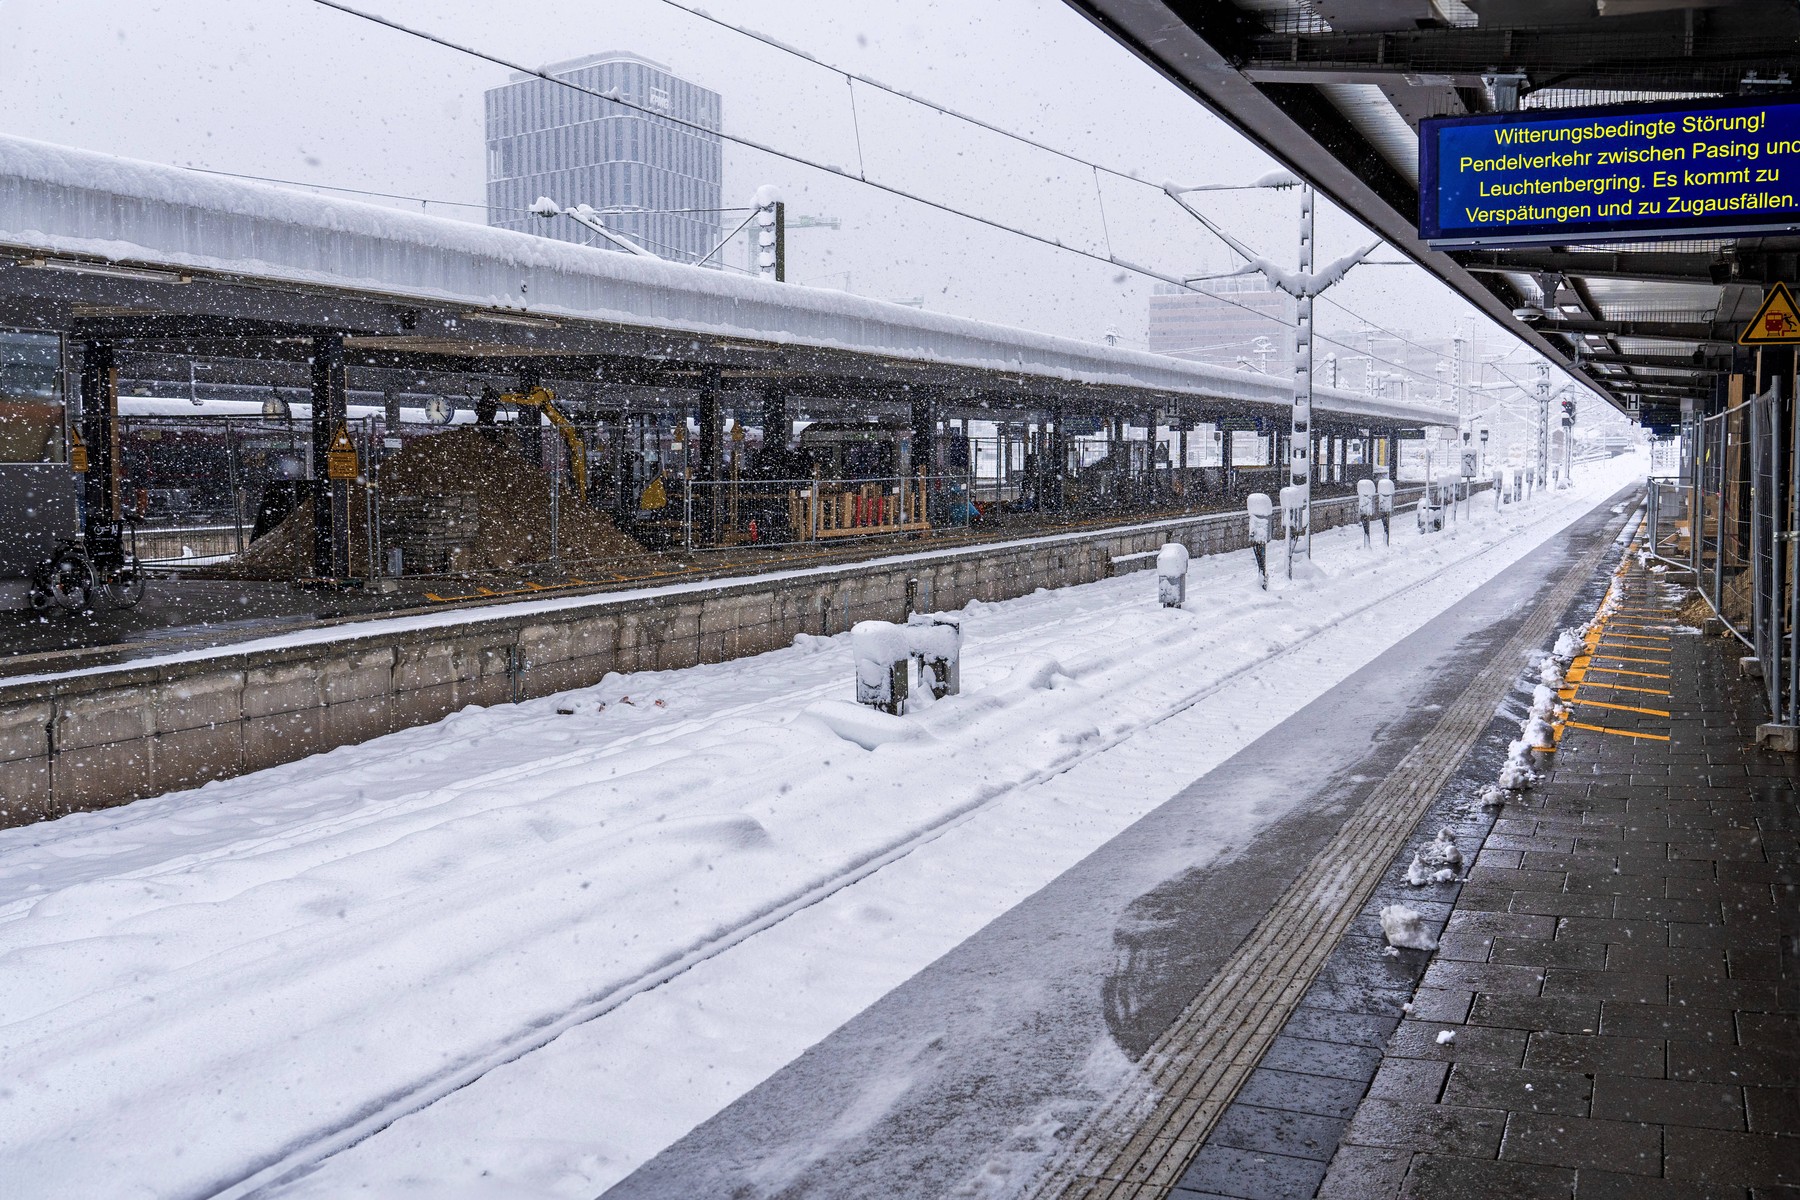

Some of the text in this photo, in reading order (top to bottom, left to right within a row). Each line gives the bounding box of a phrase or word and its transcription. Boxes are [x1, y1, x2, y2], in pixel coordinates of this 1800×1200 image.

[1494, 111, 1766, 145] Witterungsbedingte Störung!
[1460, 150, 1593, 173] Pendelverkehr
[1597, 146, 1686, 166] zwischen
[1692, 140, 1760, 160] Pasing
[1479, 166, 1779, 198] Leuchtenbergring. Es kommt zu
[1465, 191, 1800, 225] Verspätungen und zu Zugausfällen.
[1628, 394, 1638, 410] H
